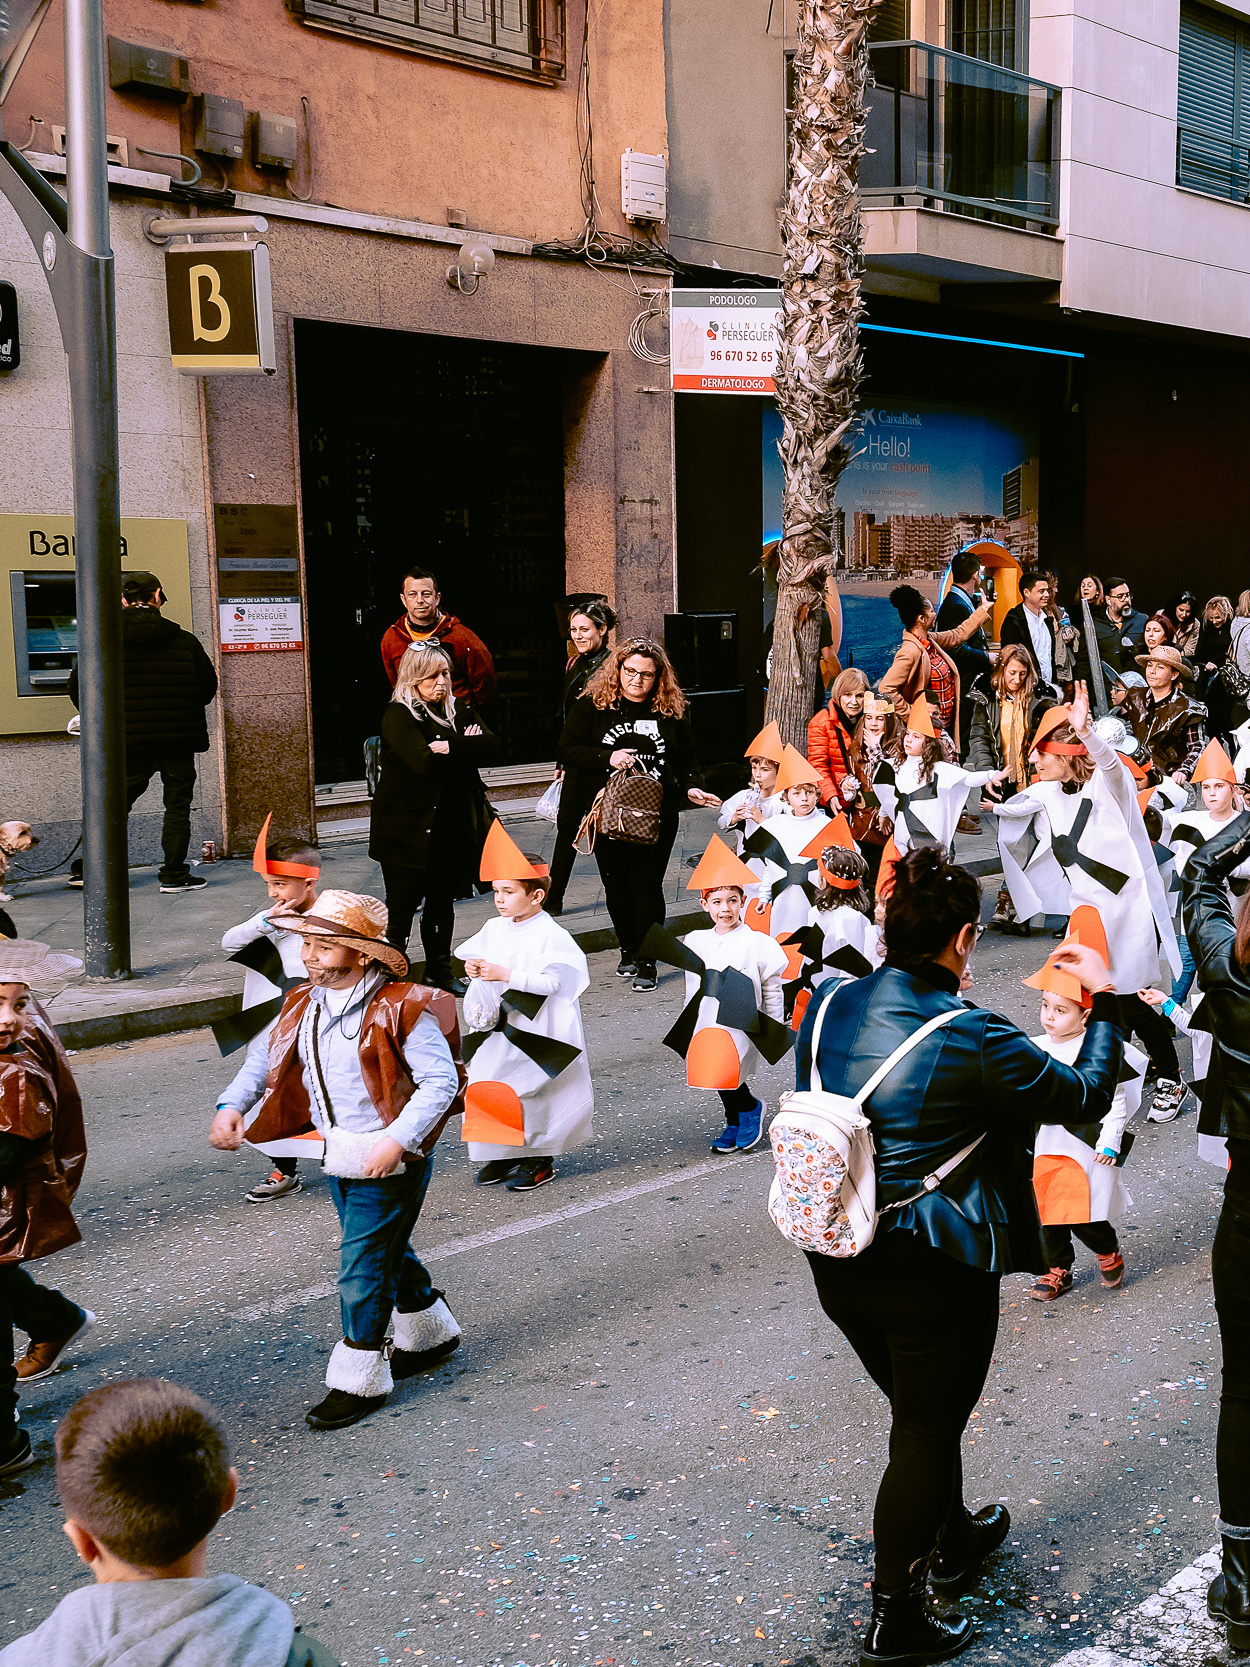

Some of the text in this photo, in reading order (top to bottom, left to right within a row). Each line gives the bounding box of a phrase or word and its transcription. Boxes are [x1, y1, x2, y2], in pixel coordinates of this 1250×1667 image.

[189, 264, 231, 342] B
[709, 295, 757, 305] PODOLOGO
[721, 321, 775, 330] CLINICA
[721, 330, 775, 341] PERSEGUER
[710, 350, 773, 362] 96 670 52 65
[701, 377, 765, 389] DERMATOLOGO
[878, 409, 922, 426] CaixaBank
[869, 434, 911, 458] Hello!
[890, 461, 908, 473] cash
[910, 463, 931, 475] point
[29, 530, 128, 556] Baa
[247, 613, 288, 621] PERSEGUER
[602, 722, 666, 754] WISCSIN
